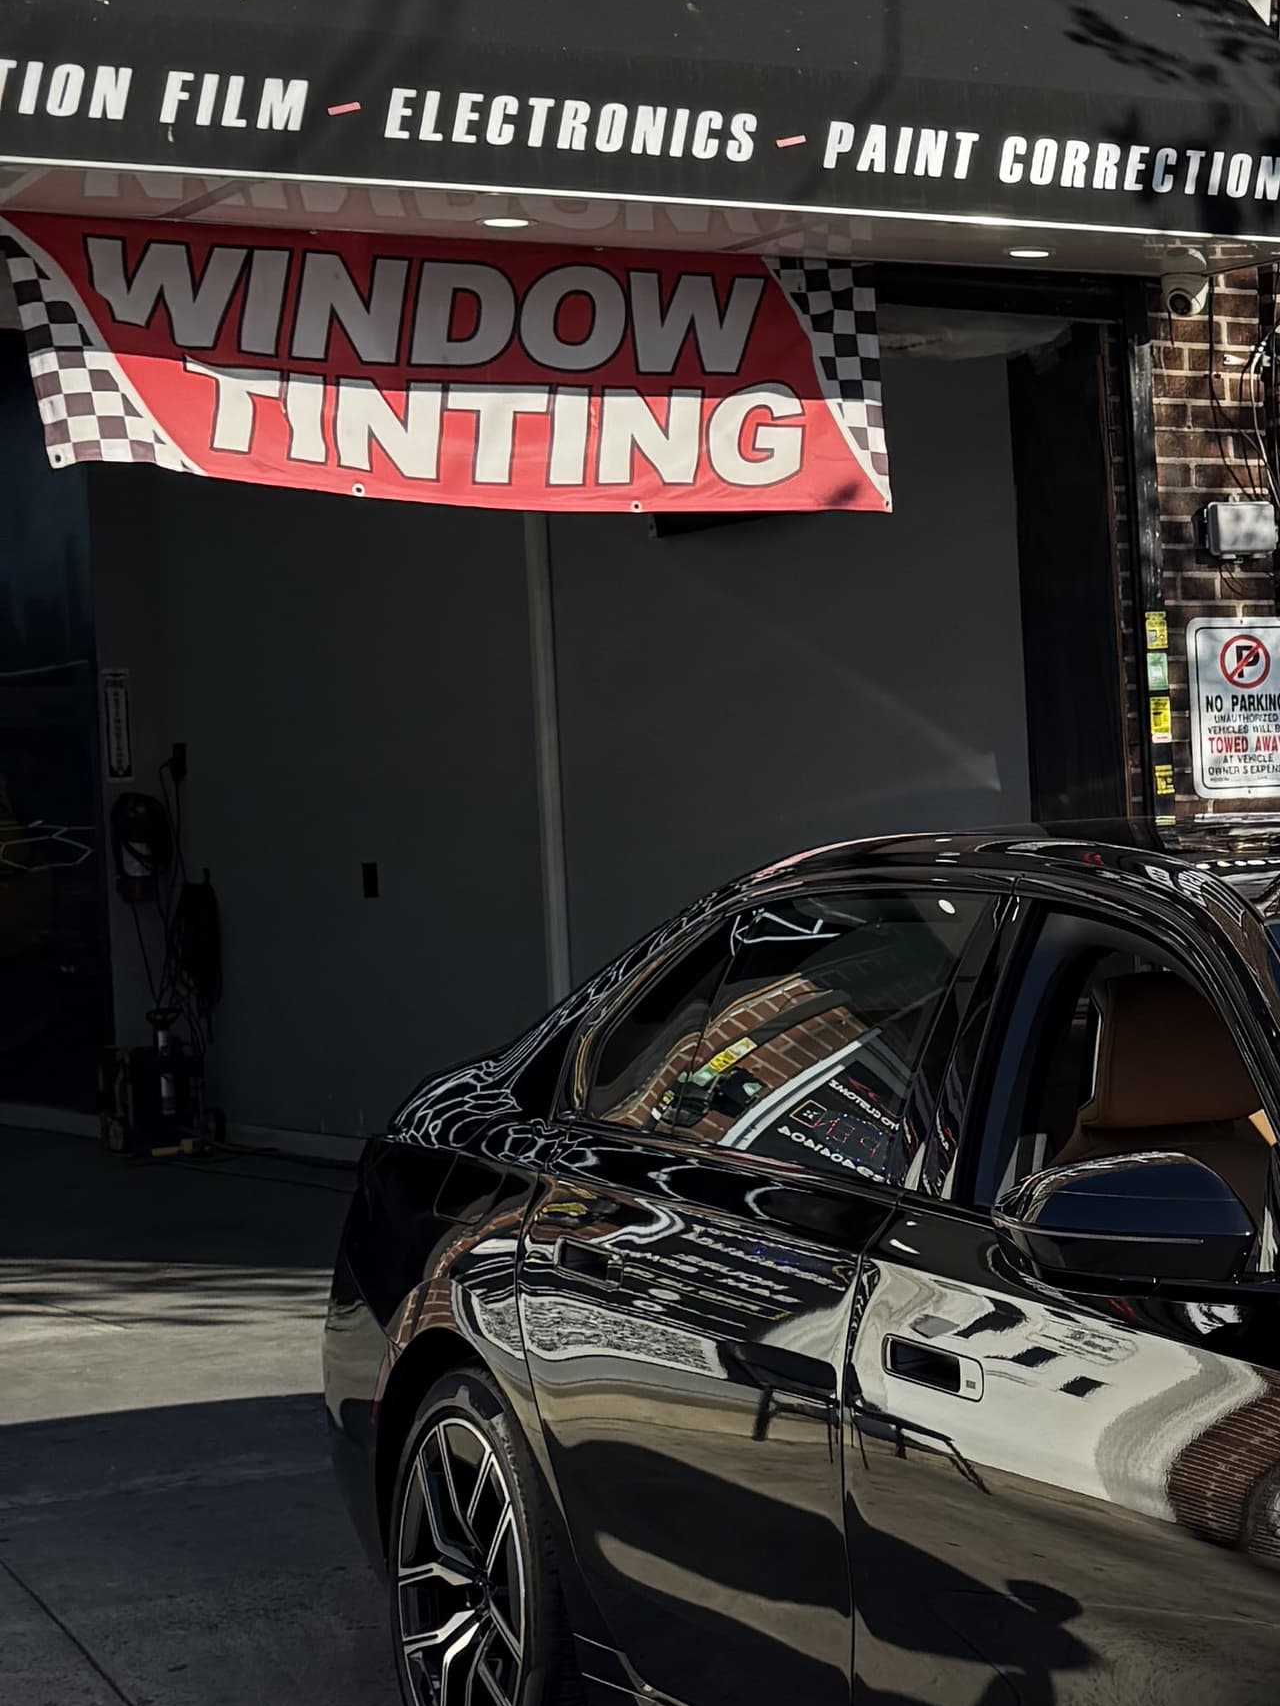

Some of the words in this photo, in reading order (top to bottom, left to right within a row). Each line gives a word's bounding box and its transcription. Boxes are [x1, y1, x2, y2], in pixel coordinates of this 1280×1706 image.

[159, 70, 310, 131] FILM
[384, 86, 759, 163] ELECTRONICS
[822, 120, 982, 181] PAINT
[82, 235, 767, 375] WINDOW
[184, 356, 806, 488] TINTING
[1205, 694, 1223, 712] NO
[1208, 724, 1249, 734] VEHICLES
[1208, 735, 1249, 754] TOWED
